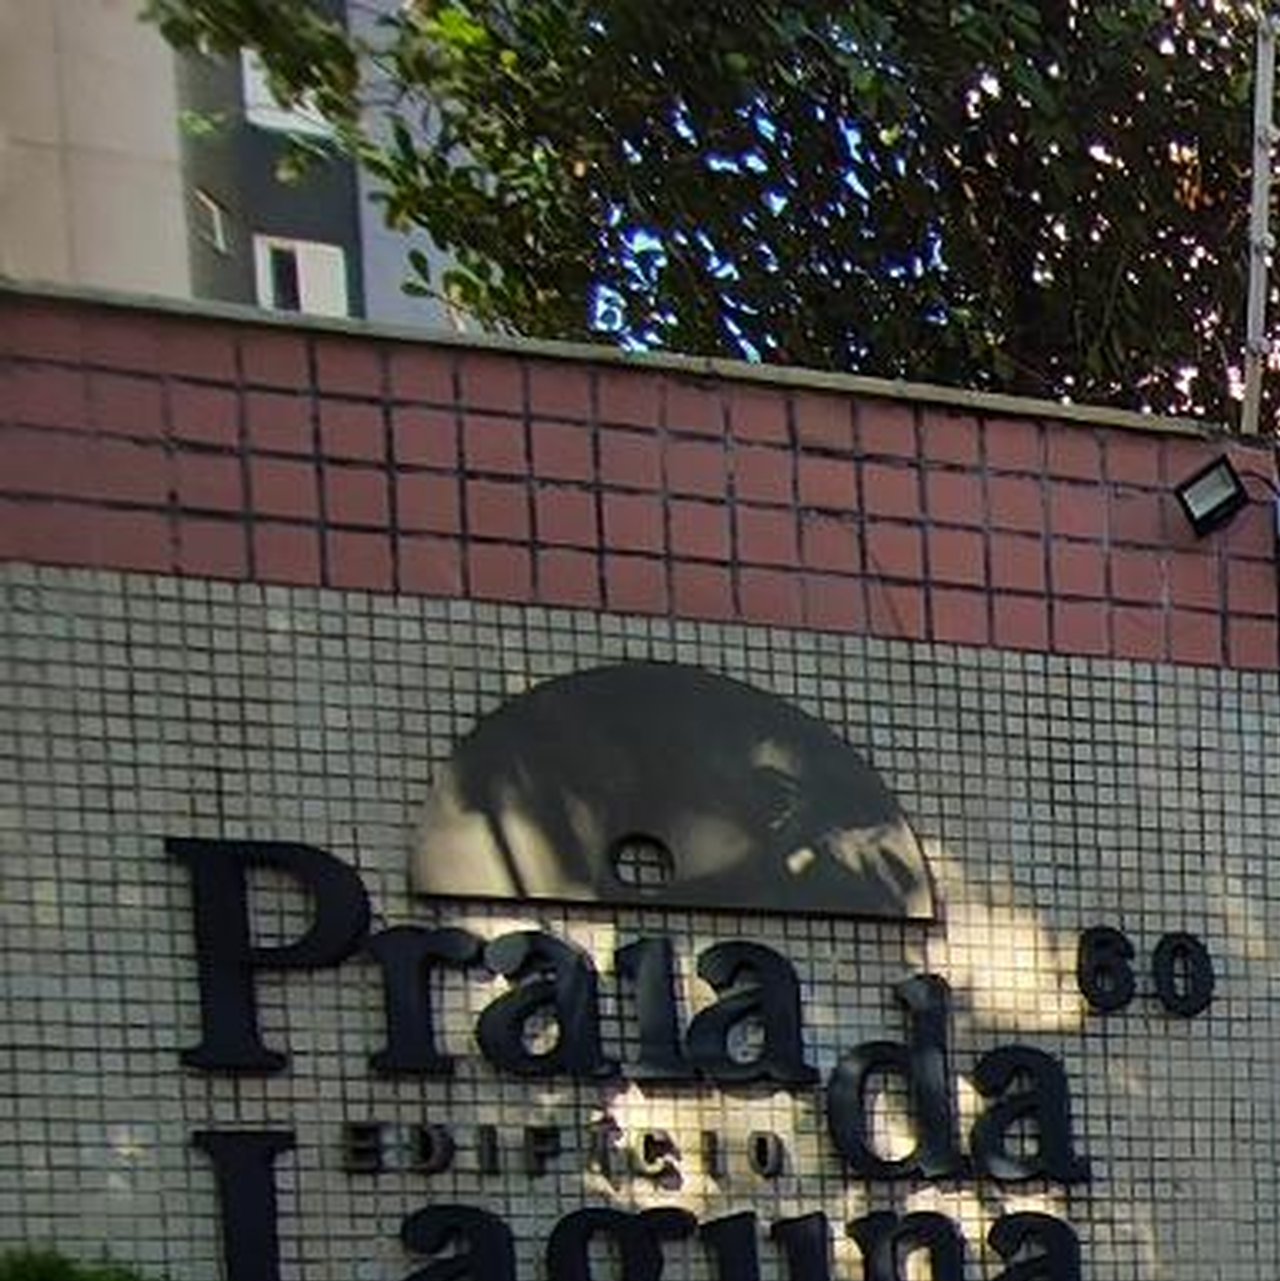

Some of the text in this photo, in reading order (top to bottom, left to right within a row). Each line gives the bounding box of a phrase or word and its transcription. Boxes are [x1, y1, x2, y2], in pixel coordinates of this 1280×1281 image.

[165, 838, 1093, 1183] Praia da
[1078, 925, 1215, 1017] 60
